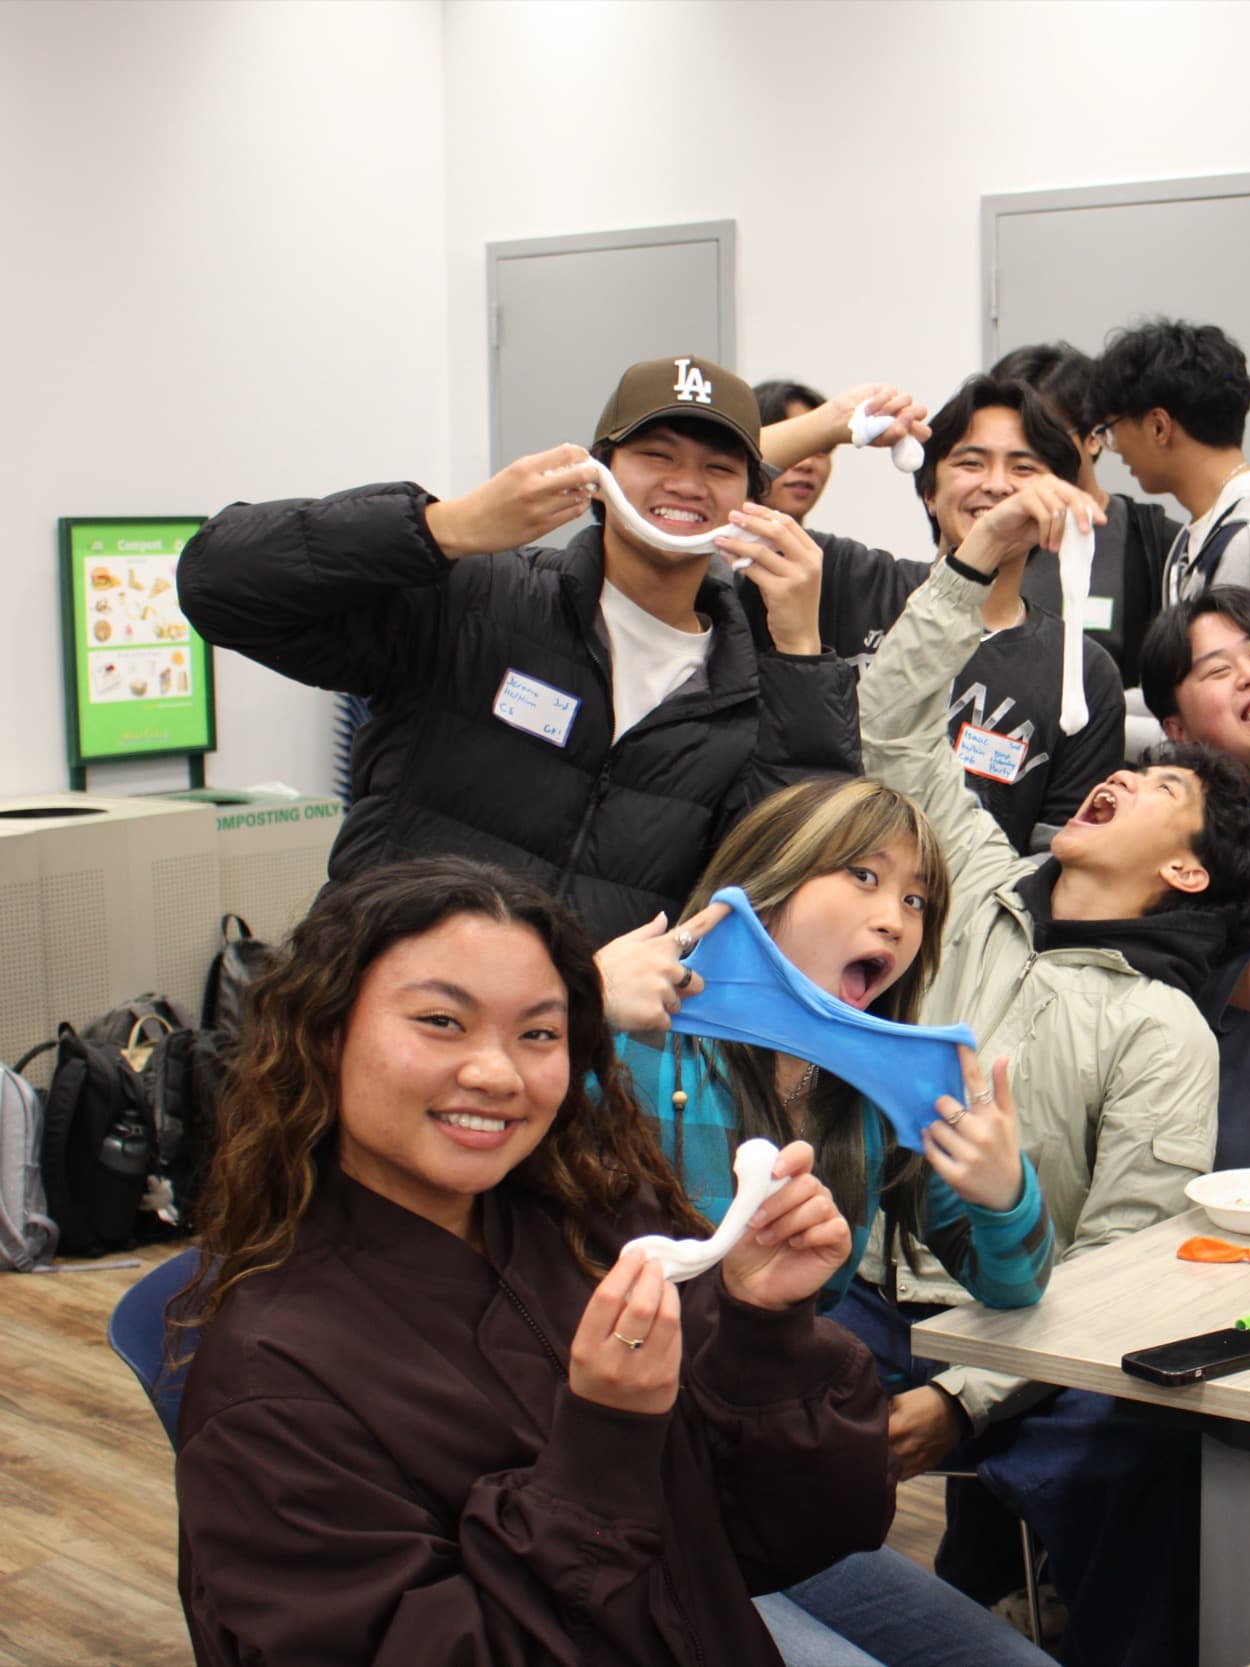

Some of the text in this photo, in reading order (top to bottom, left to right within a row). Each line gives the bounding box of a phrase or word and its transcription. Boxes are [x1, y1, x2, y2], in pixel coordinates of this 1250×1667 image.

[673, 359, 712, 404] LA
[117, 539, 163, 553] Compost
[216, 801, 340, 832] MPOSTING ONLY
